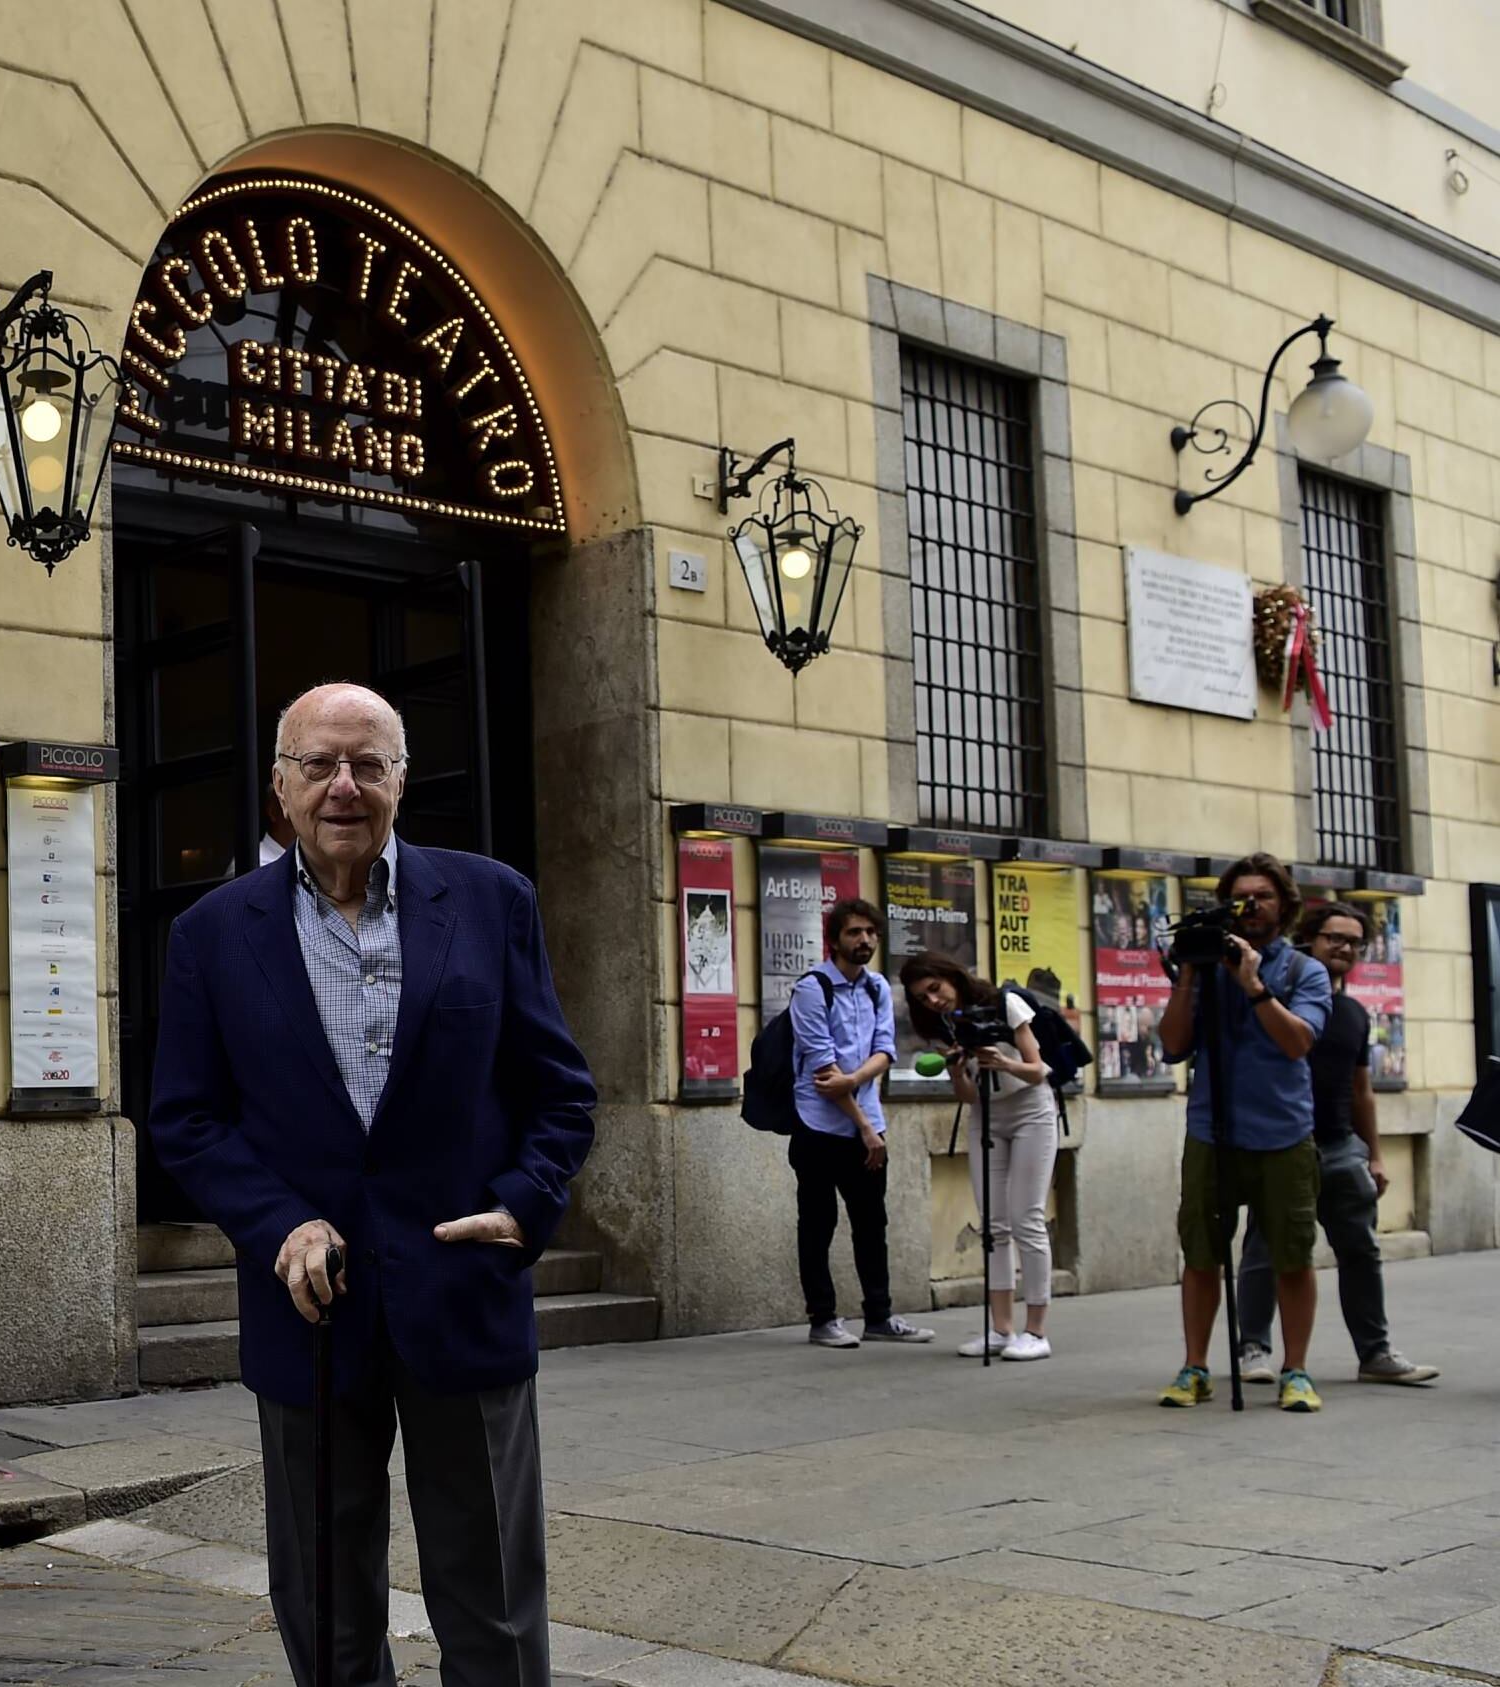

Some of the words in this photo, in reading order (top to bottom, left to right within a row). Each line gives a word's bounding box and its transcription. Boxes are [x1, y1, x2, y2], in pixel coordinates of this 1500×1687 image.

[357, 230, 536, 496] TEATRO
[383, 371, 422, 417] DI
[242, 401, 425, 476] MILANO
[40, 747, 104, 767] PICCOLO
[713, 808, 754, 825] PICCOLO
[765, 877, 789, 897] Art
[790, 879, 836, 901] Bonus
[997, 875, 1028, 891] TRA
[999, 895, 1030, 912] MED
[1000, 917, 1029, 932] AUT
[1001, 936, 1030, 952] ORE
